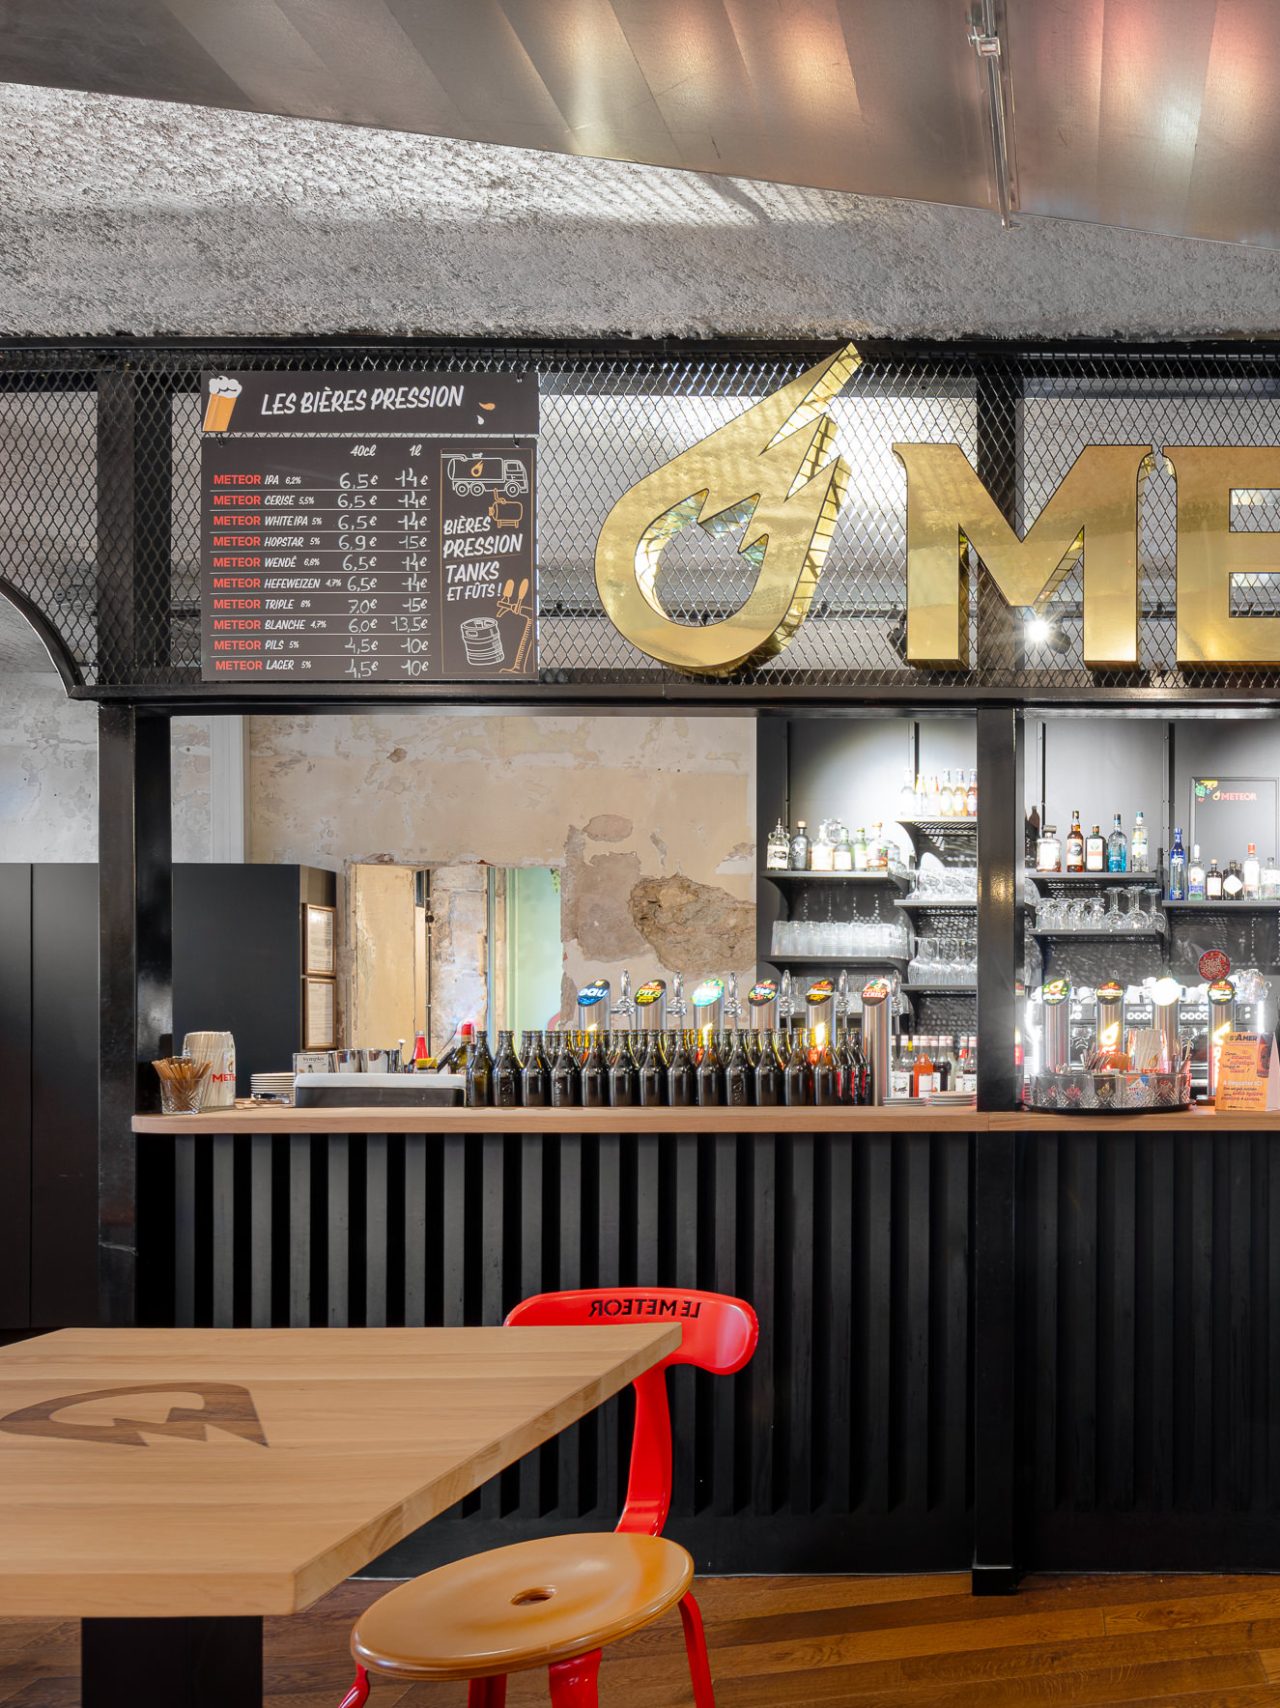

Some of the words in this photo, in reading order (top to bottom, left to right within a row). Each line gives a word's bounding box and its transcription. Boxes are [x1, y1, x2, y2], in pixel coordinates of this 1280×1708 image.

[261, 394, 296, 415] LES
[300, 387, 367, 413] BIÈRES
[371, 385, 464, 410] PRESSION
[214, 474, 261, 484] METEOR
[264, 475, 279, 485] IPA
[214, 496, 261, 505] METEOR
[264, 495, 295, 505] CERISE
[299, 497, 314, 505] 5,5%
[214, 516, 261, 526] METEOR
[311, 517, 322, 525] 5%
[443, 516, 491, 535] BIÈRES
[214, 537, 261, 546] METEOR
[264, 536, 304, 547] HOPSTAR
[310, 537, 320, 545] 5%
[443, 533, 523, 558] PRESSION
[214, 558, 261, 567] METEOR
[445, 561, 500, 584] TANKS
[214, 578, 261, 588] METEOR
[264, 578, 320, 589] HEFEWEIZEN
[447, 585, 463, 601] ET
[465, 583, 495, 599] FÛTS
[214, 599, 261, 609] METEOR
[265, 599, 294, 610] TRIPLE
[214, 620, 261, 630] METEOR
[265, 620, 306, 630] BLANCHE
[214, 640, 261, 650] METEOR
[265, 640, 284, 650] PILS
[288, 641, 299, 649] 5%
[216, 661, 263, 670] METEOR
[266, 659, 295, 670] LAGER
[301, 661, 312, 669] 5%
[1220, 792, 1257, 801] METEOR
